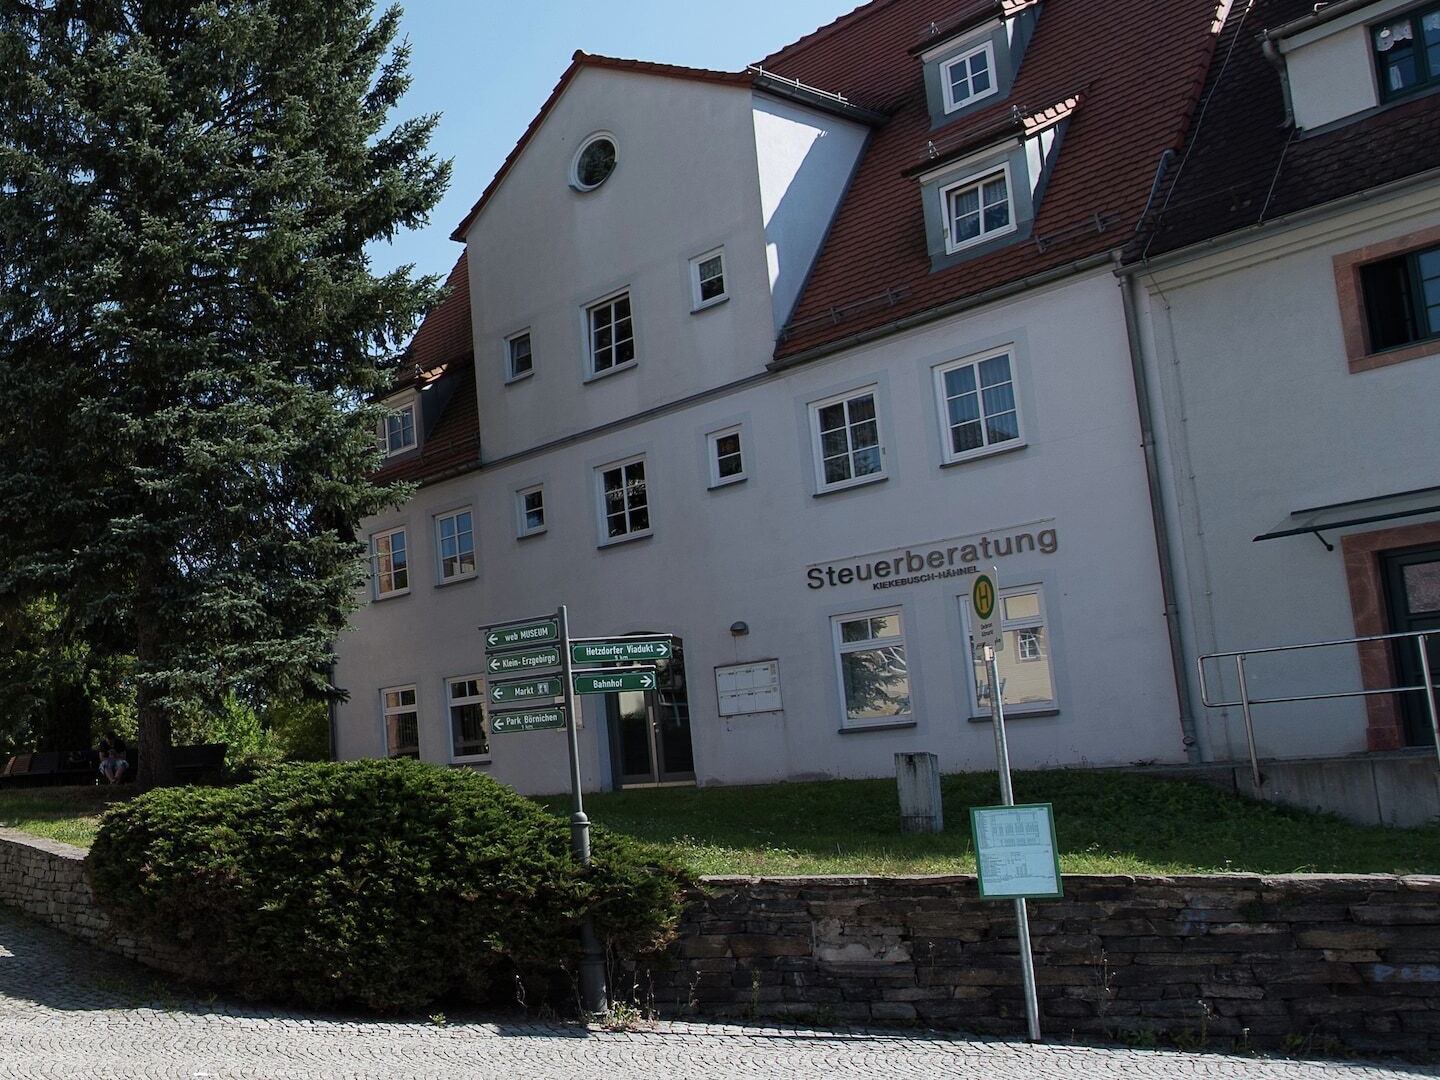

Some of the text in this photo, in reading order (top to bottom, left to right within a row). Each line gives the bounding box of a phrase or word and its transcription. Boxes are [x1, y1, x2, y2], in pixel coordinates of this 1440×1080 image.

[806, 528, 1058, 590] Steuerberatung
[872, 565, 981, 591] KIEKEBUSCH-HÄHNEL
[978, 584, 989, 610] H
[505, 627, 548, 641] web MUSEUM
[586, 644, 654, 656] Hetzdorfer Viadukt
[522, 653, 556, 666] Erzgebirge
[593, 678, 623, 689] Bahnhof
[514, 686, 534, 696] Markt
[506, 713, 558, 726] Park Börnichen
